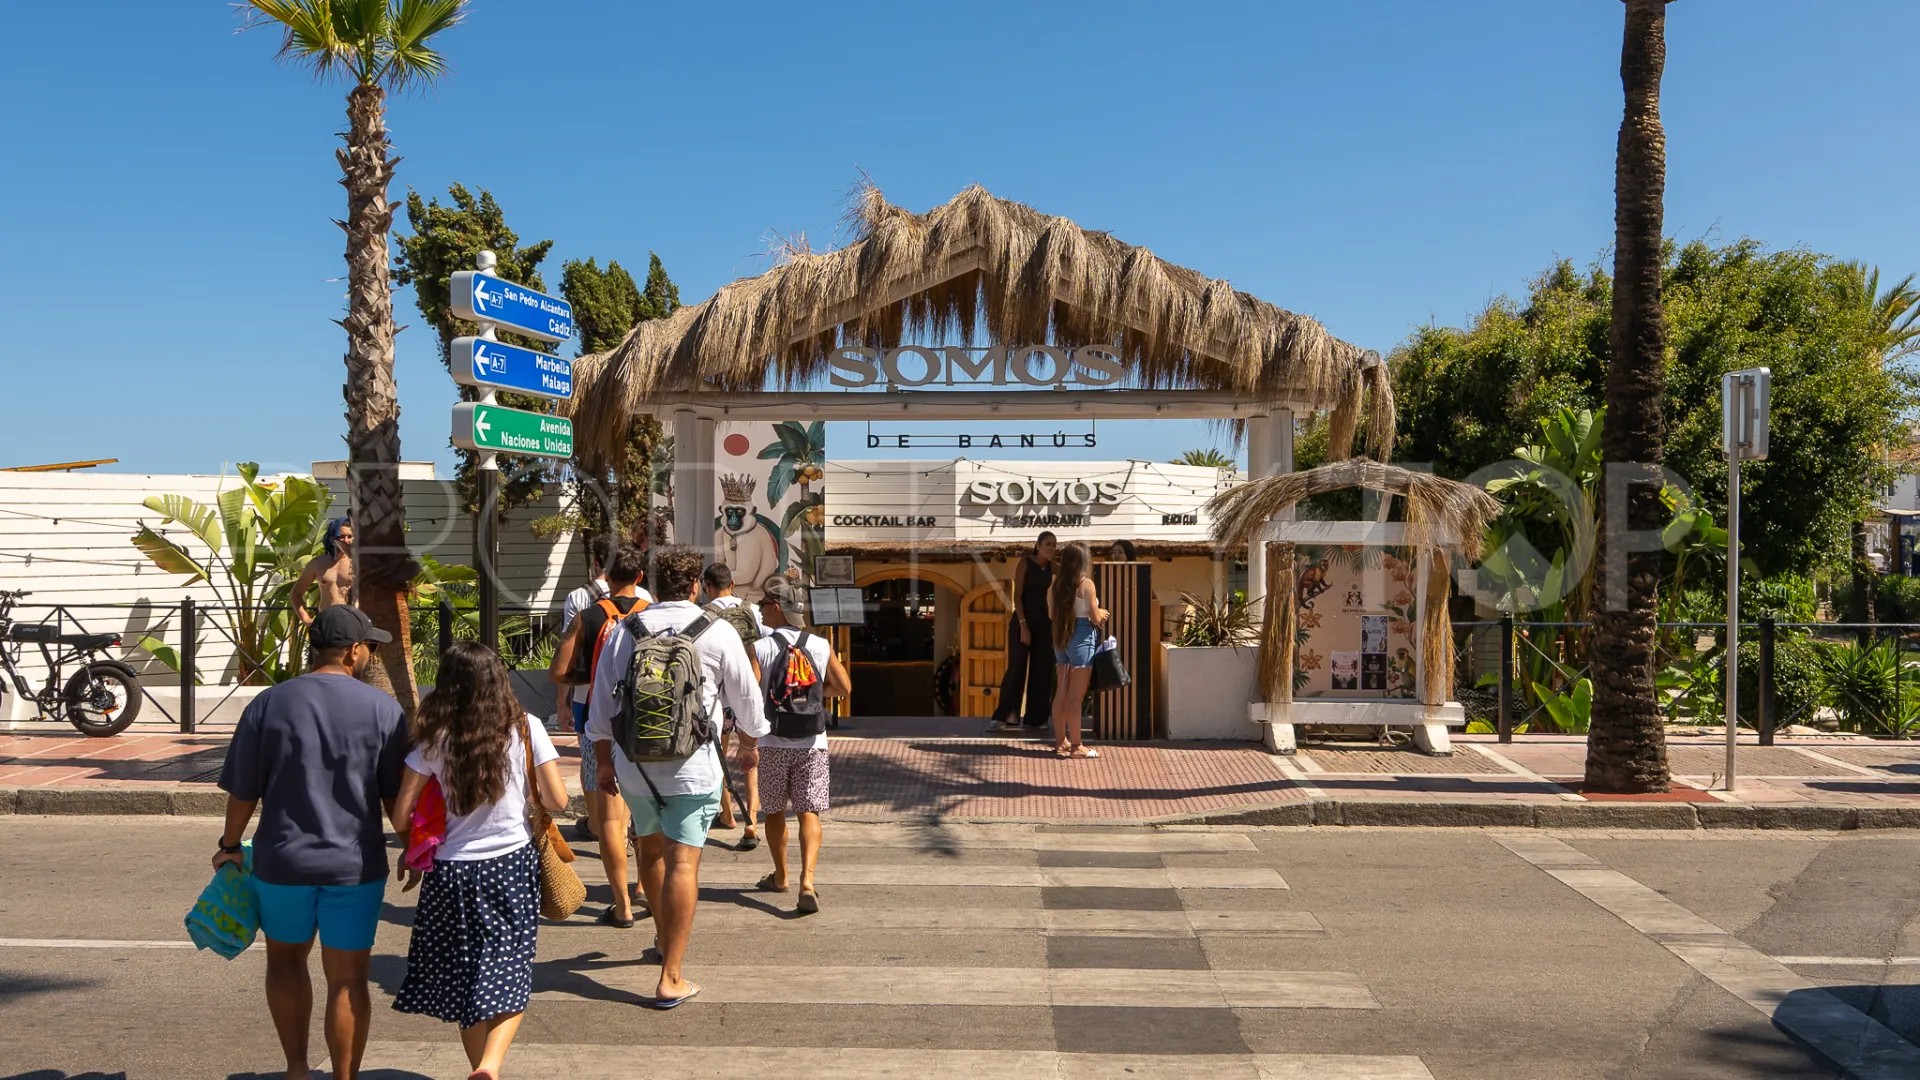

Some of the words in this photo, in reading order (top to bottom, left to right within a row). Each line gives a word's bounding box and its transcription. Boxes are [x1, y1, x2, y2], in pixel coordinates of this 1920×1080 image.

[491, 294, 503, 307] A-7
[504, 287, 518, 301] San
[519, 292, 539, 309] Pedro
[540, 296, 570, 319] Alcántara
[548, 320, 570, 337] Cádiz
[491, 356, 505, 371] A-7
[535, 355, 570, 376] Marbella
[829, 344, 1125, 387] SOMOS
[542, 374, 570, 394] Málaga
[540, 418, 571, 437] Avenida
[501, 431, 540, 450] Naciones
[544, 437, 571, 454] Unidas
[867, 433, 911, 449] DE
[958, 430, 1097, 449] BANÚS
[970, 479, 1124, 505] SOMOS
[833, 515, 904, 527] COCKTAIL
[907, 515, 936, 527] BAR
[1003, 514, 1092, 528] RESTAURANTE
